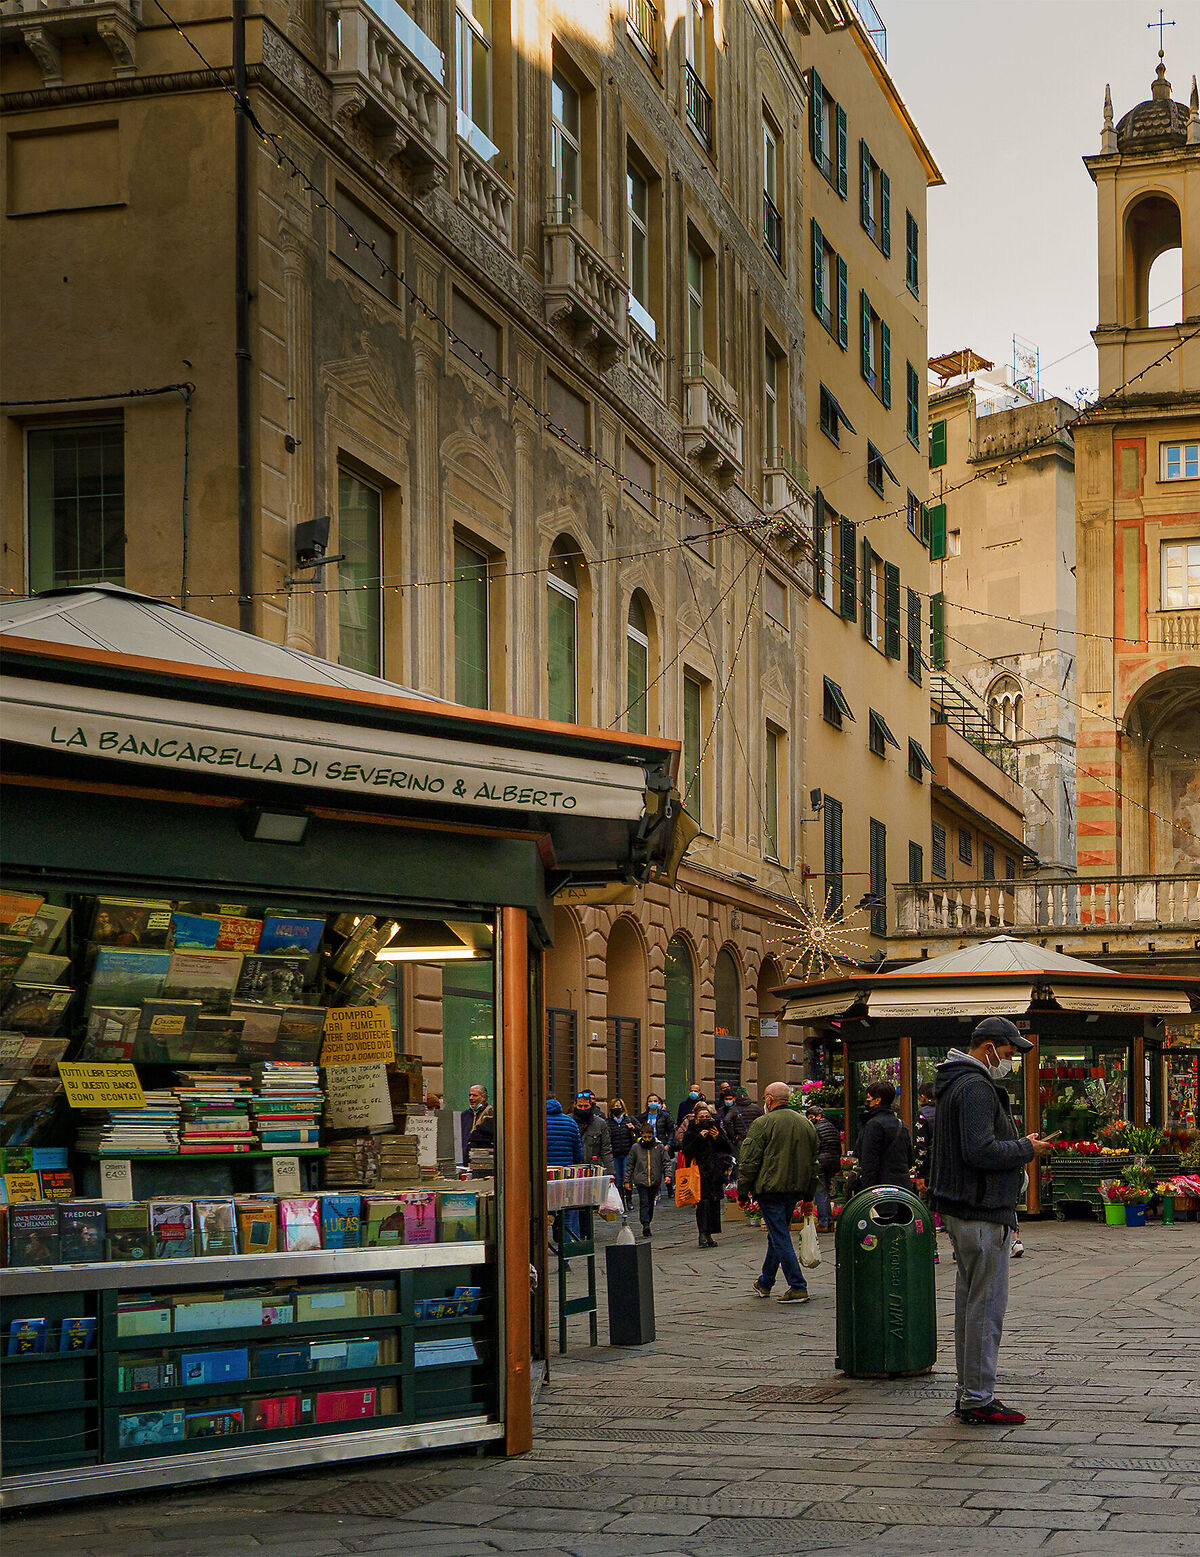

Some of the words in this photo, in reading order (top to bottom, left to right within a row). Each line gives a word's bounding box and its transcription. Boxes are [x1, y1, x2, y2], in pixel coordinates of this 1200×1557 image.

[50, 726, 88, 748] LA
[99, 731, 283, 774] BANCARELLA
[291, 757, 318, 777] DI
[325, 761, 445, 793] SEVERINO
[452, 778, 467, 798] &
[474, 782, 577, 809] ALBERTO
[331, 1010, 374, 1020] COMPRO
[326, 1022, 343, 1032] IBRI
[350, 1019, 386, 1031] FUMETTI
[346, 1030, 390, 1041] BIBLIOTECHE
[344, 1043, 354, 1052] CD
[355, 1041, 376, 1051] VIDEO
[377, 1040, 391, 1049] DVD
[332, 1054, 350, 1062] RECO
[358, 1051, 393, 1061] DOMICILIO
[61, 1069, 81, 1077] TUTTI
[87, 1069, 105, 1077] LIBRI
[68, 1081, 78, 1089] SU
[82, 1081, 110, 1089] QUESTO
[113, 1081, 137, 1089] BANCO
[71, 1093, 95, 1101] SONO
[100, 1093, 141, 1101] SCONTATI
[324, 1216, 360, 1233] LUCAS
[889, 1293, 903, 1340] AMIU
